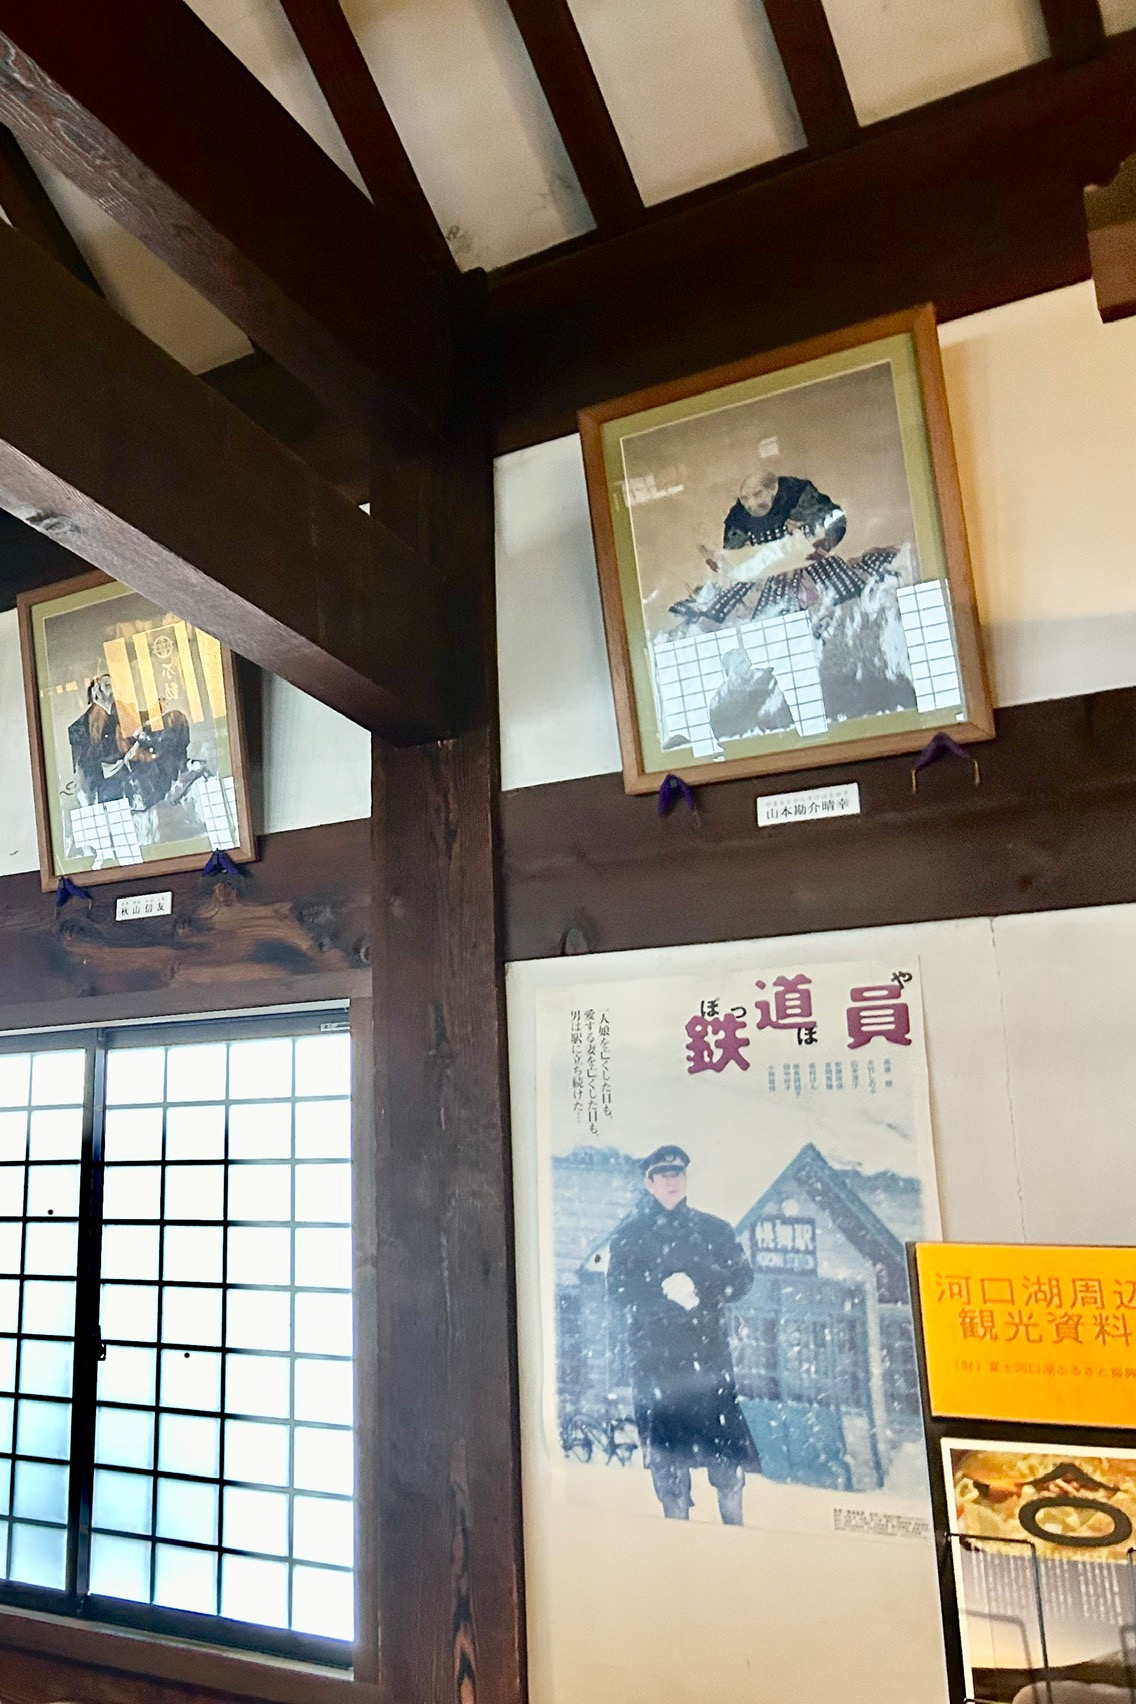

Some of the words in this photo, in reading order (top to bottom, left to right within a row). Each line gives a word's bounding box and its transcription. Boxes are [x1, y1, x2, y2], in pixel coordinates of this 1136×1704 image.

[891, 970, 913, 989] や
[685, 973, 913, 1075] 鉄道員
[936, 1272, 1136, 1310] 河口湖周辺
[959, 1308, 1132, 1347] 観光資料
